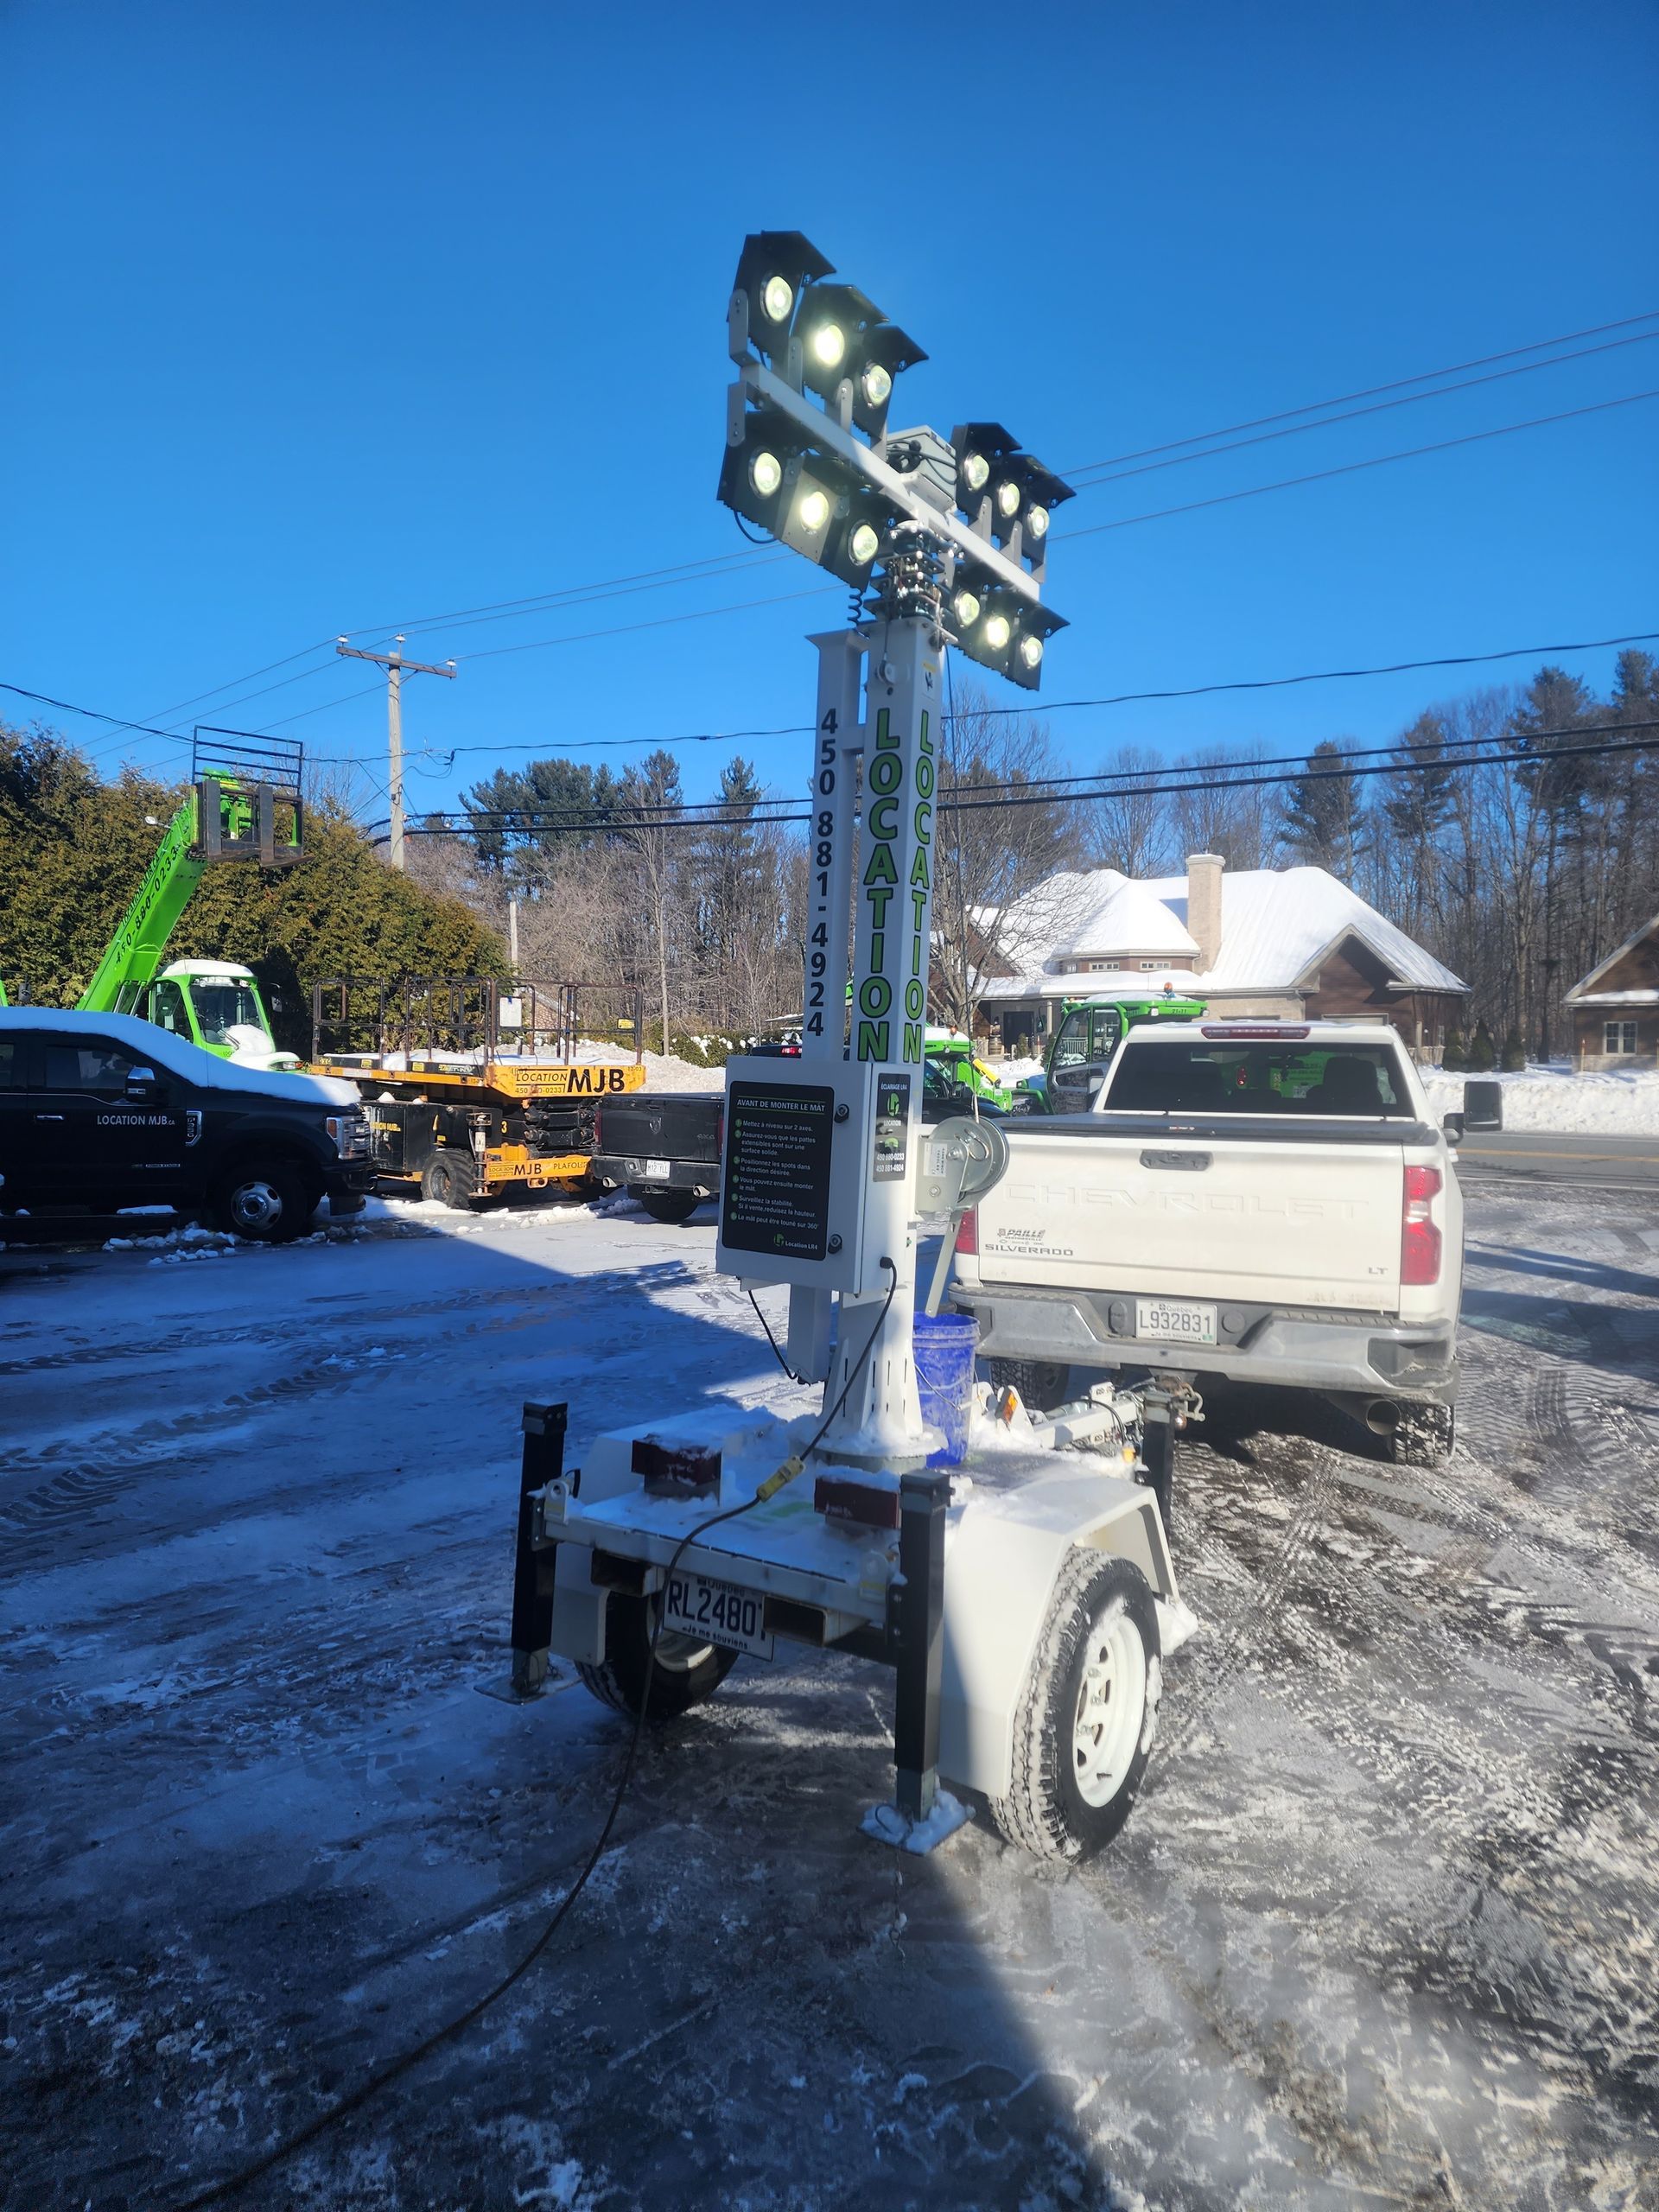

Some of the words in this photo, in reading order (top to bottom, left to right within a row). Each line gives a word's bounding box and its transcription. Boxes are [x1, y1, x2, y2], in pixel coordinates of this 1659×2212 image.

[819, 709, 838, 795] 450
[858, 708, 903, 1061] LOCATION
[903, 710, 935, 1063] LOCATION
[807, 810, 834, 1037] 881-4924
[516, 1073, 568, 1082] LOCATION
[567, 1069, 625, 1093] MJB
[770, 1102, 799, 1110] MONTER
[97, 1115, 145, 1125] LOCATION
[513, 1163, 542, 1175] MJB
[741, 1158, 771, 1166] Positionnez
[781, 1161, 796, 1170] spots
[1002, 1183, 1370, 1219] CHEVROLET
[785, 1241, 808, 1249] Location
[985, 1243, 1073, 1256] SILVERADO
[1140, 1310, 1211, 1334] L932831
[687, 1624, 696, 1635] Je
[699, 1629, 711, 1638] me
[713, 1632, 748, 1649] souviens
